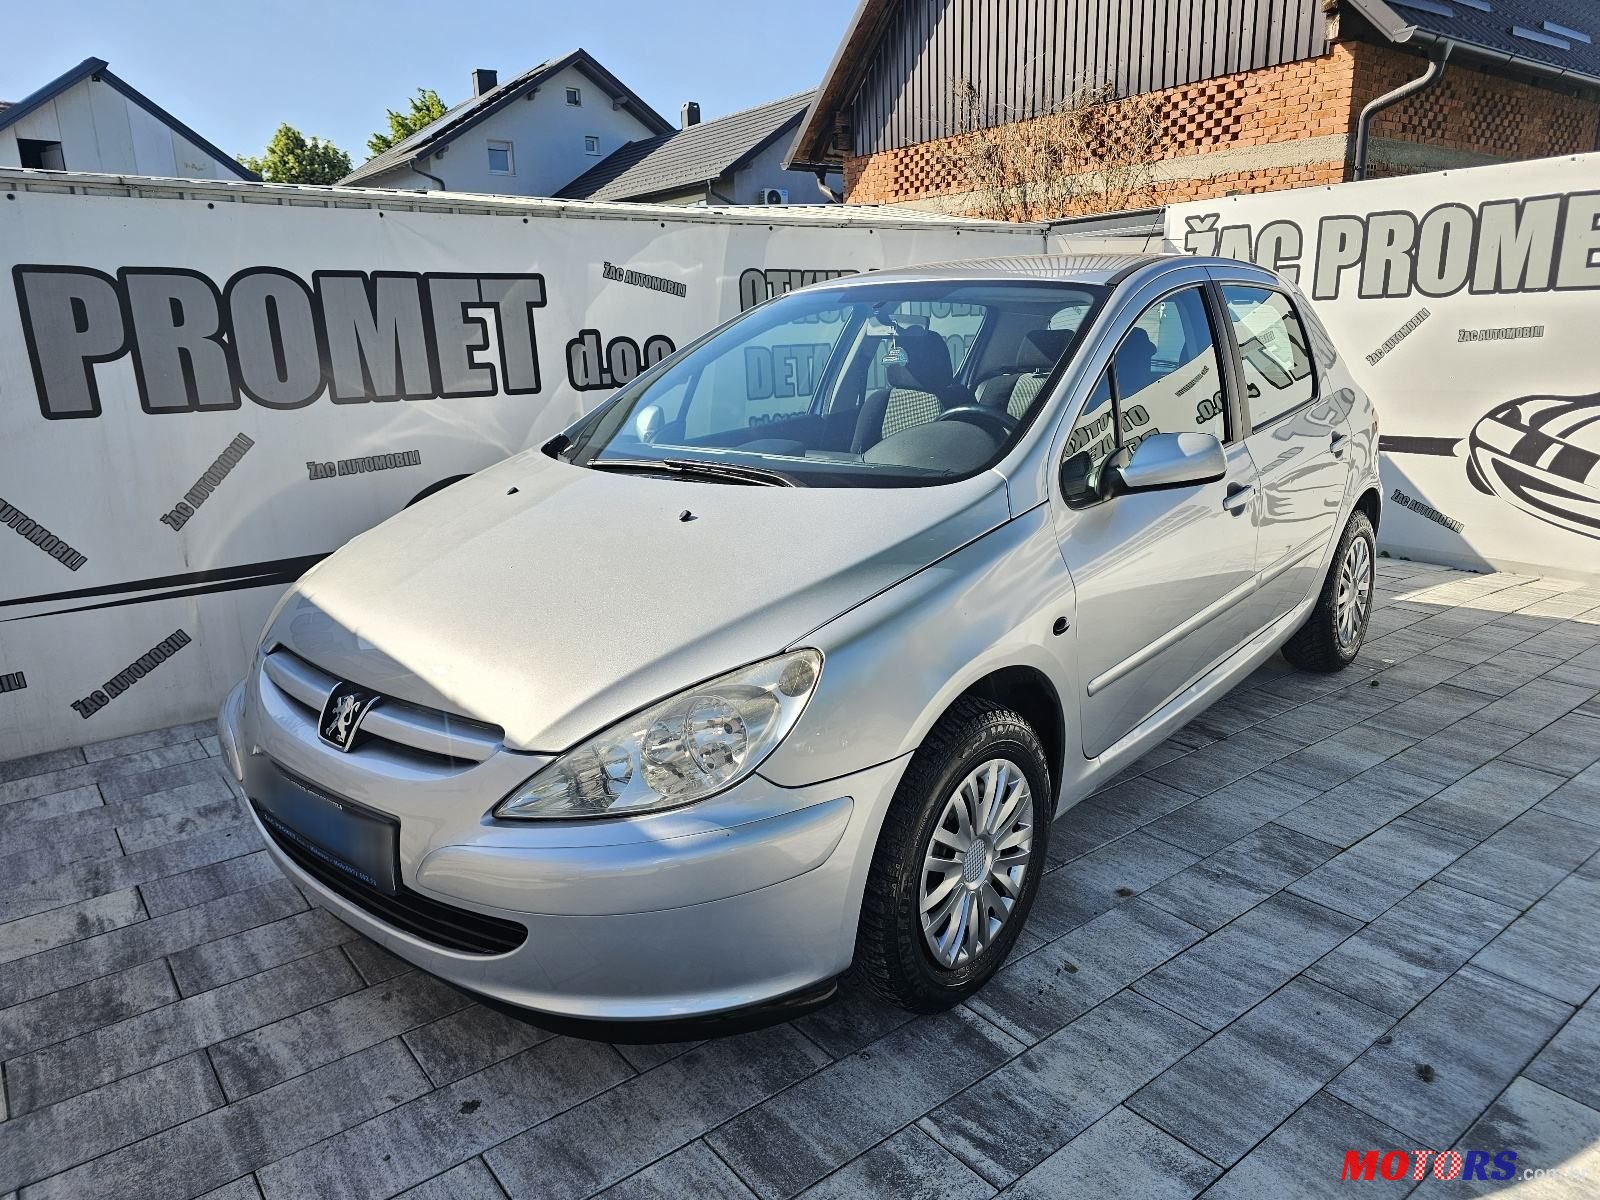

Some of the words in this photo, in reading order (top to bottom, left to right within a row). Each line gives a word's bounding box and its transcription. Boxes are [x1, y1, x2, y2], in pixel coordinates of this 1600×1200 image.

[602, 261, 625, 282] ŽAC
[624, 269, 687, 298] AUTOMOBILI
[12, 263, 547, 420] PROMET
[1365, 348, 1385, 367] ŽAC
[1381, 307, 1431, 353] AUTOMOBILI
[1457, 327, 1479, 343] ŽAC
[1478, 325, 1545, 341] AUTOMOBILI
[160, 501, 195, 532] ŽAC
[184, 432, 255, 510] AUTOMOBILI
[306, 461, 337, 481] ŽAC
[337, 450, 422, 476] AUTOMOBILI
[1390, 488, 1411, 507] ŽAC
[1407, 499, 1465, 534] AUTOMOBILI
[70, 690, 110, 720] ŽAC
[102, 628, 192, 699] AUTOMOBILI
